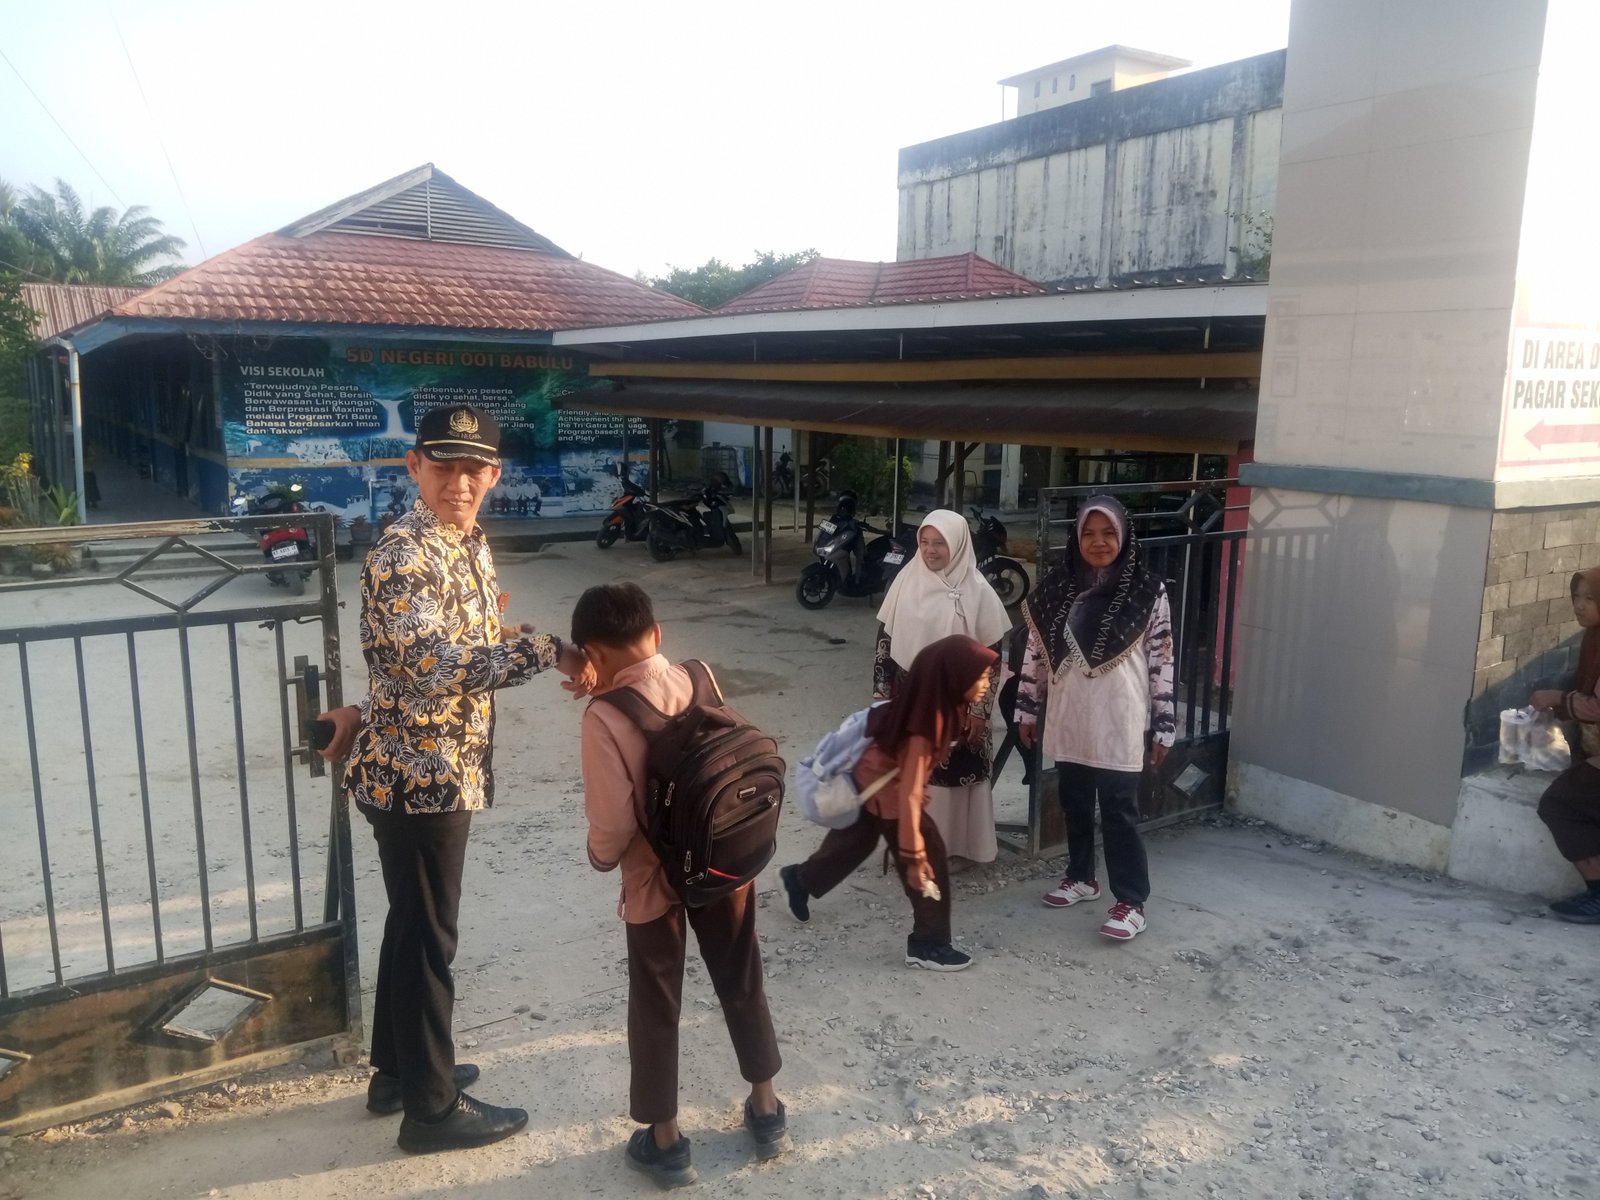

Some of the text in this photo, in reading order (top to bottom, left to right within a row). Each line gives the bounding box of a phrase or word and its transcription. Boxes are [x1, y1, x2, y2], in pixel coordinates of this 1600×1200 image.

[1522, 339, 1540, 368] DI
[1543, 340, 1584, 369] AREA
[347, 348, 374, 362] SD
[381, 350, 454, 365] NEGERI
[500, 354, 573, 369] BABULU
[240, 366, 325, 377] VISI SEKOLAH
[275, 391, 301, 399] yang
[1513, 380, 1600, 409] PAGAR SEK
[245, 397, 313, 405] Berwawasan
[268, 405, 329, 414] Berprestasi
[288, 413, 332, 421] Program
[289, 420, 353, 428] berdasarkan
[356, 420, 381, 428] Iman
[246, 427, 266, 435] dan
[558, 428, 592, 436] Program
[1091, 613, 1114, 660] IRWAN
[1108, 549, 1136, 614] GINAWAN
